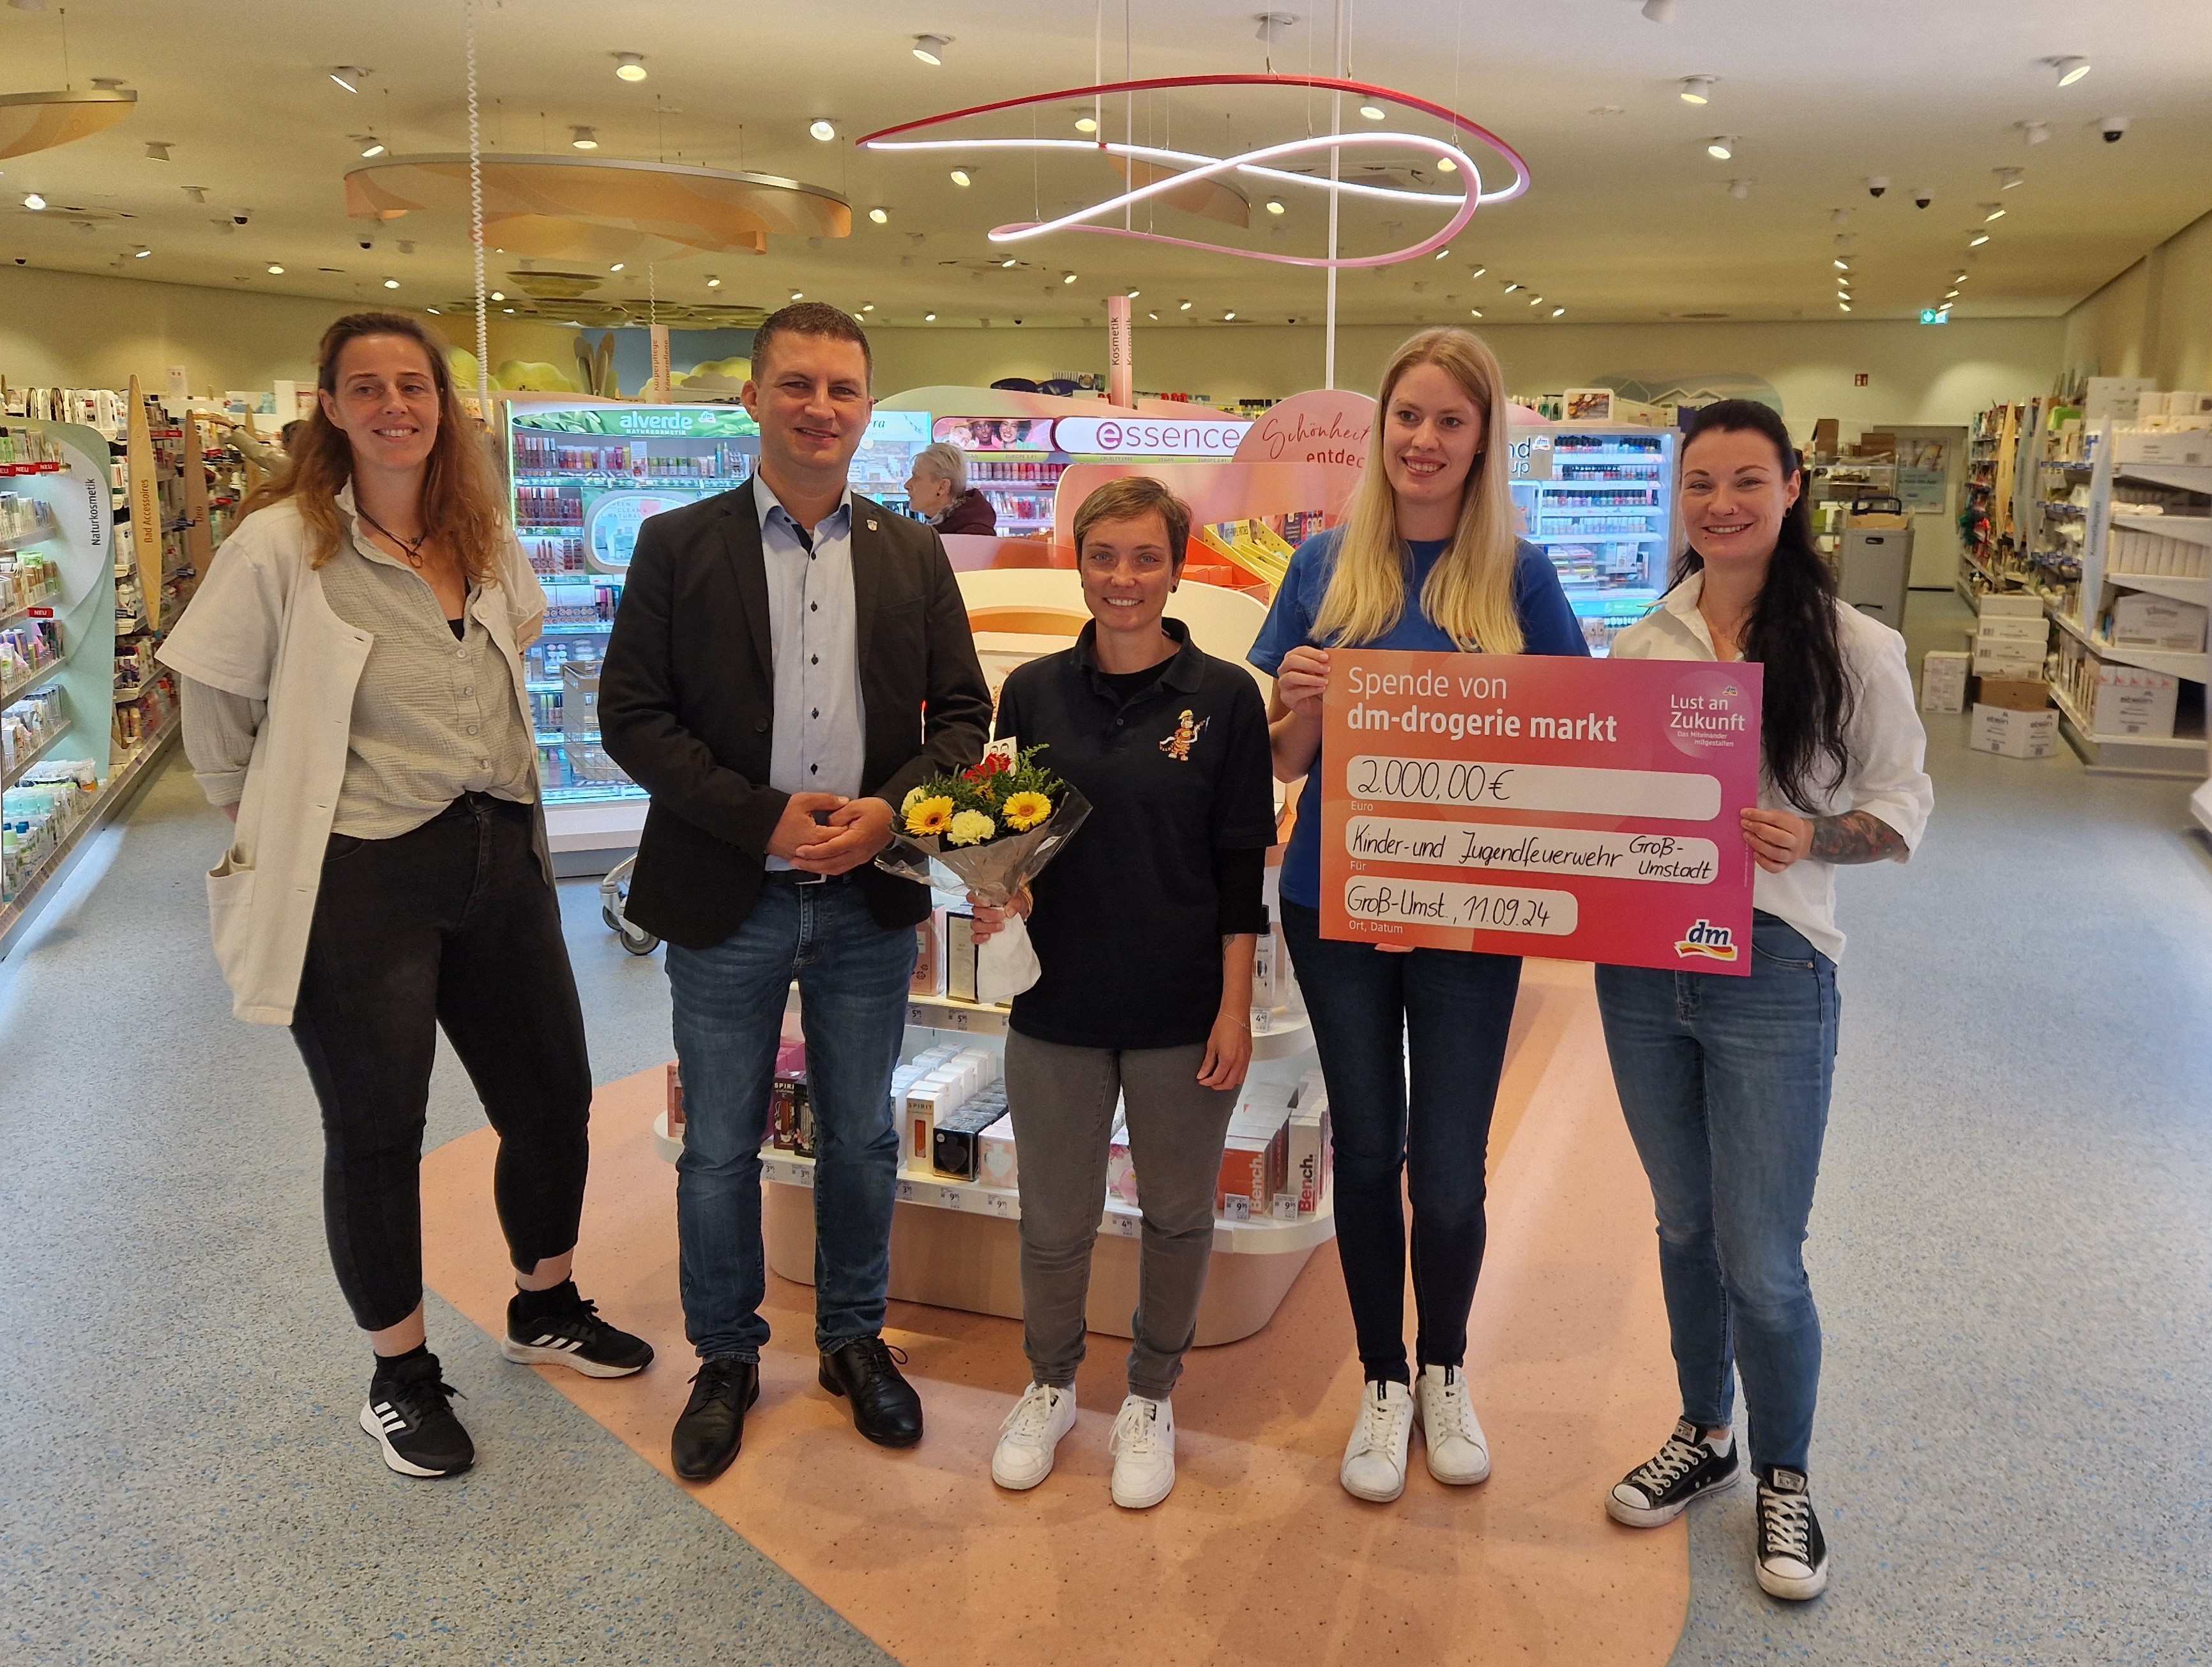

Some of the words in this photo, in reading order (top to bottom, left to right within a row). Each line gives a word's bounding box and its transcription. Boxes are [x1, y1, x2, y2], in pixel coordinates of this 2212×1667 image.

[1110, 316, 1120, 366] Kosmetik
[619, 410, 693, 430] alverde
[1096, 422, 1241, 451] essence
[1262, 411, 1372, 459] Schönheit
[1306, 448, 1366, 469] entdec
[84, 478, 101, 545] Naturkosmetik
[139, 479, 152, 526] Accessoires
[142, 528, 153, 543] Bad
[1348, 666, 1449, 701] Spende
[1458, 676, 1507, 699] von
[1670, 694, 1704, 710] Lust
[1708, 699, 1728, 710] an
[1347, 702, 1521, 741] dm-drogerie
[1529, 712, 1617, 742] markt
[1670, 711, 1746, 731] Zukunft
[1690, 731, 1727, 740] Miteinander
[1694, 739, 1734, 747] mitgestalten
[1351, 801, 1374, 811] Euro
[1458, 830, 1624, 867] Jugendfeuerwehr
[1350, 860, 1367, 871] Für
[1637, 860, 1713, 879] Umstadt
[1463, 895, 1550, 927] 11.09.24
[1349, 920, 1367, 932] Ort,
[1370, 922, 1404, 934] Datum
[1688, 921, 1729, 945] dm
[1248, 1154, 1262, 1212] Bench.
[1298, 1153, 1314, 1212] Bench.
